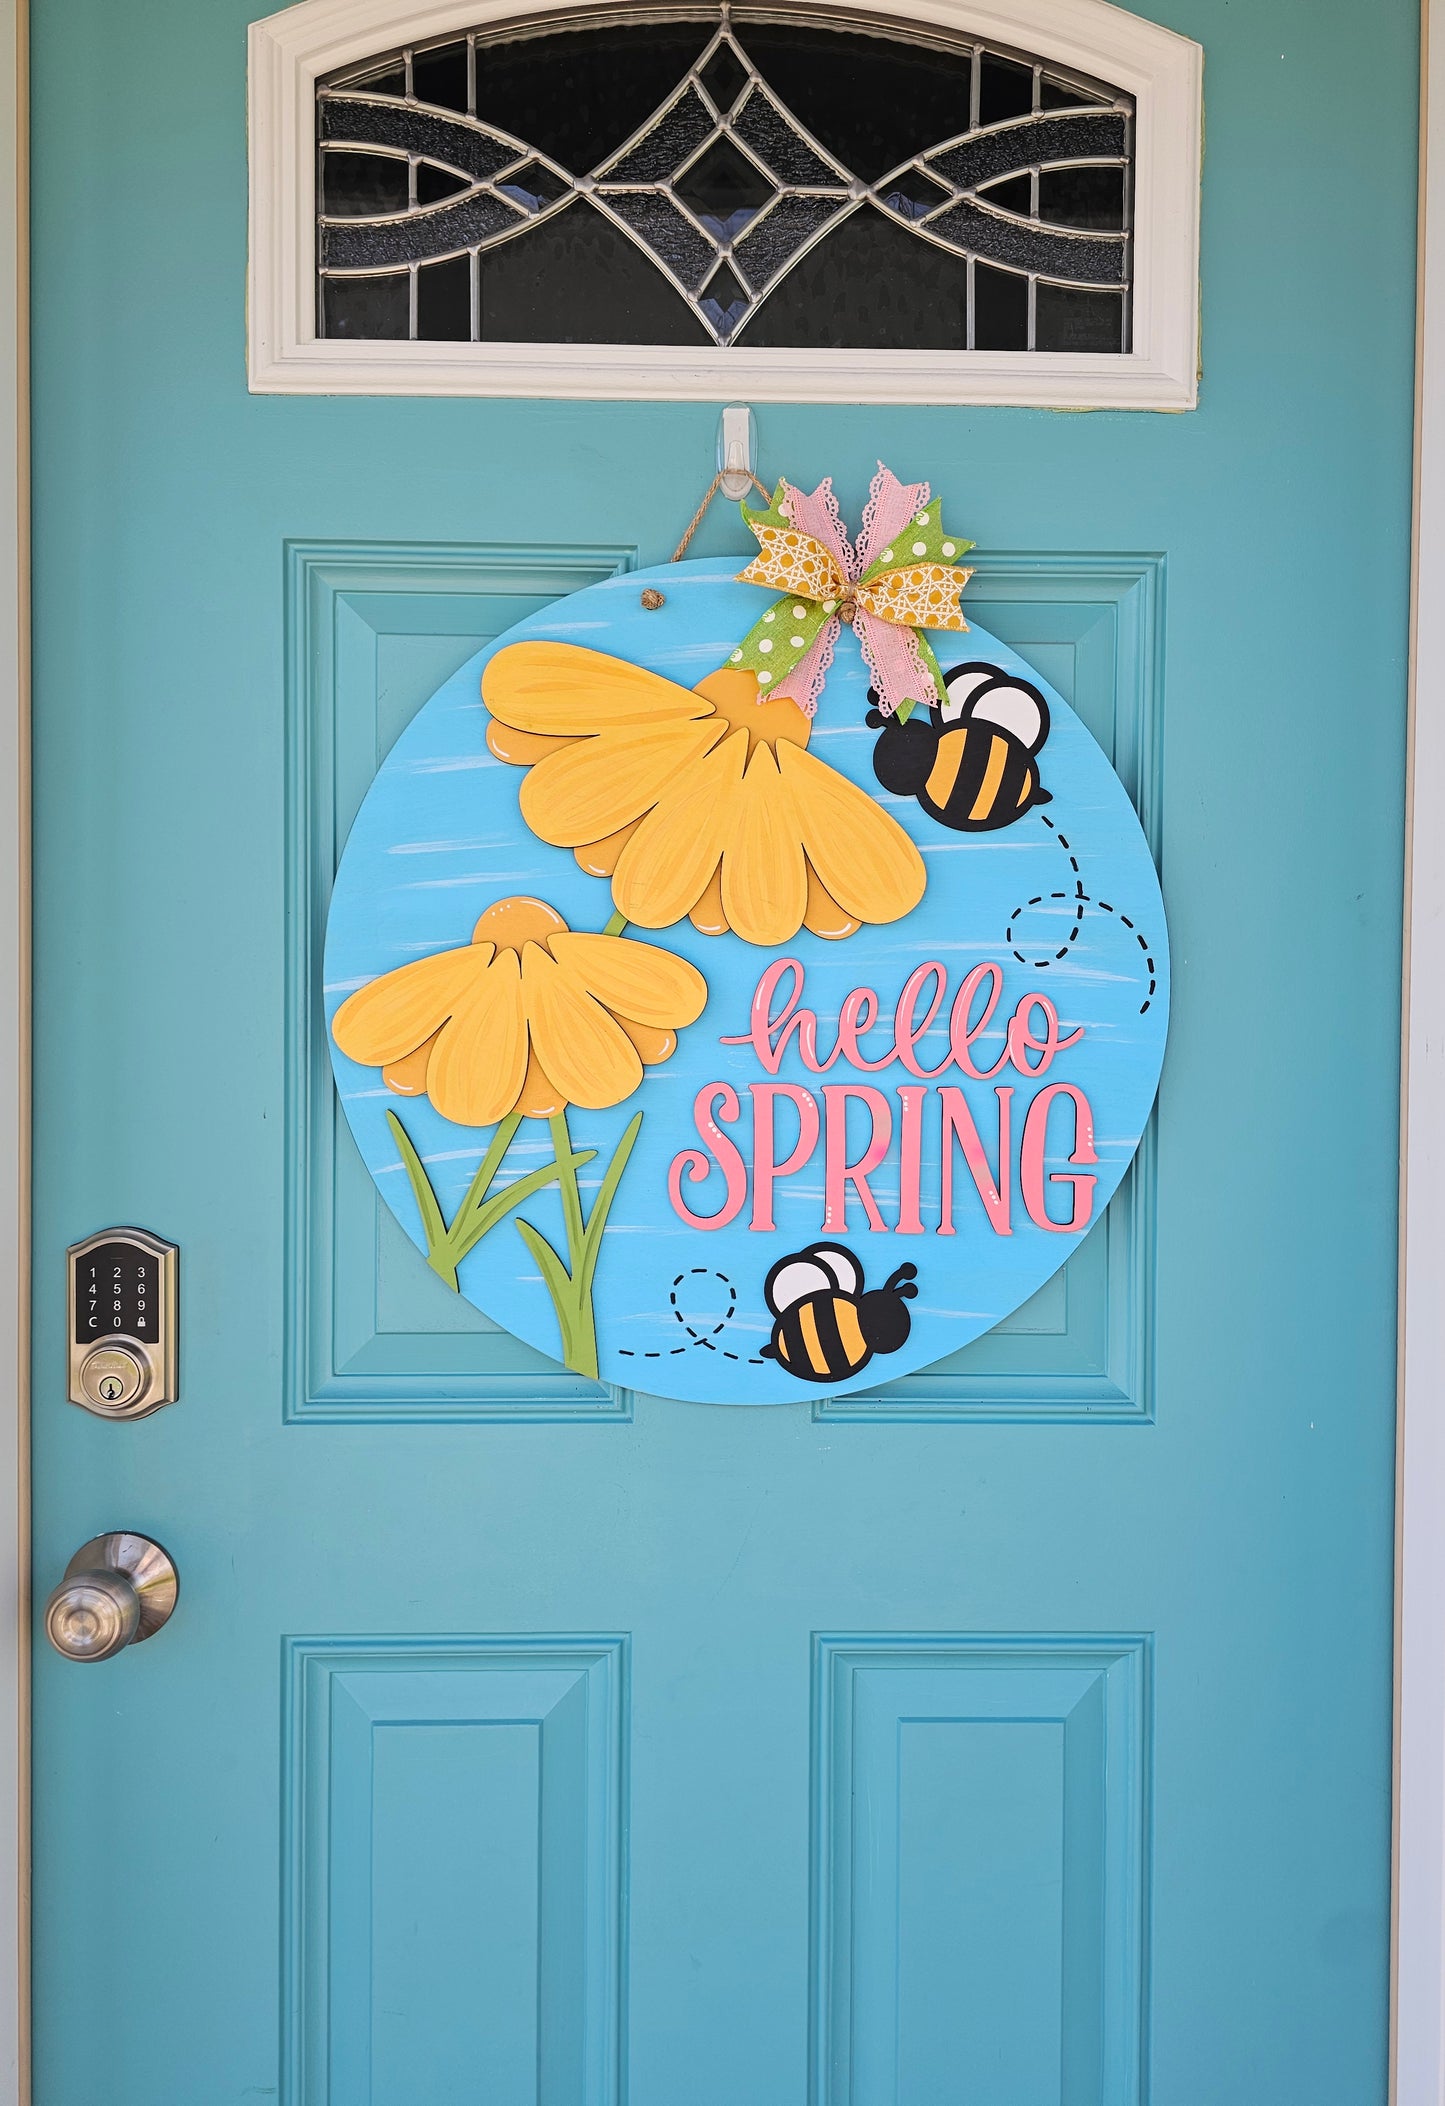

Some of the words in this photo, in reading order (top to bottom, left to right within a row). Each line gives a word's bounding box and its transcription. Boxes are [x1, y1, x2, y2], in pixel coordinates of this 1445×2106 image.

[719, 957, 1086, 1080] hello
[668, 1081, 1099, 1236] SPRING
[89, 1267, 96, 1278] 1
[113, 1267, 121, 1278] 2
[137, 1267, 146, 1278] 3
[89, 1283, 97, 1295] 4
[113, 1283, 121, 1295] 5
[137, 1283, 146, 1295] 6
[89, 1300, 97, 1311] 7
[113, 1300, 121, 1311] 8
[137, 1300, 146, 1311] 9
[88, 1316, 98, 1328] C
[113, 1316, 121, 1328] 0
